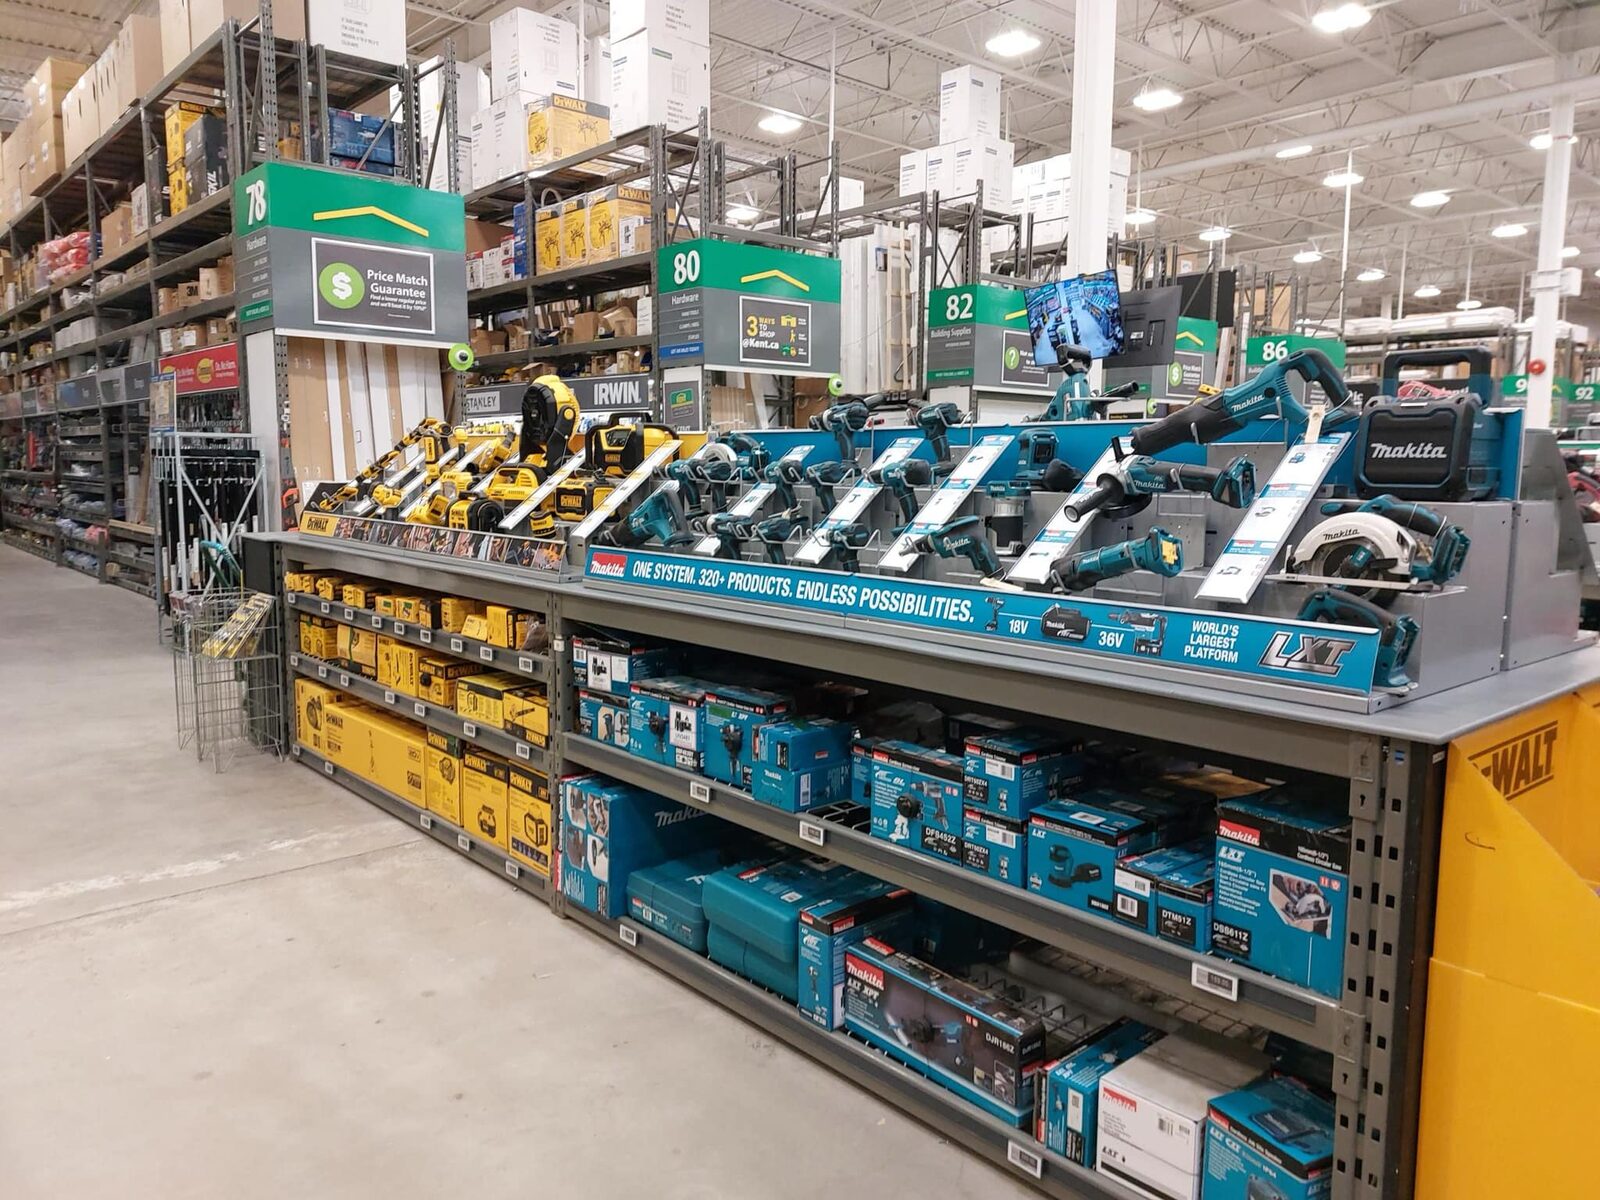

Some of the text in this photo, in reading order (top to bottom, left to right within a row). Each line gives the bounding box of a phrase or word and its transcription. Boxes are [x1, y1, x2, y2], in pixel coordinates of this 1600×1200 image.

[246, 179, 267, 226] 78
[673, 250, 700, 285] 80
[367, 269, 428, 287] Price Match
[186, 285, 198, 297] 3M
[370, 282, 426, 299] Guarantee
[671, 292, 699, 305] Hardware
[946, 293, 973, 320] 82
[746, 315, 775, 337] 3 WAYS
[930, 327, 971, 339] Building Supplies
[742, 338, 779, 349] @Kent.ca
[1262, 340, 1288, 361] 86
[594, 380, 640, 405] IRWIN
[1515, 378, 1527, 393] 9
[1575, 387, 1595, 400] 92
[632, 560, 974, 623] ONE SYSTEM. 320+ PRODUCTS. ENDLESS POSSIBILITIES.
[1008, 619, 1029, 634] 18V
[1192, 620, 1240, 636] WORLD'S
[1098, 631, 1124, 648] 36V
[1190, 633, 1237, 649] LARGEST
[1184, 645, 1239, 663] PLATFORM
[1258, 630, 1356, 678] LXT
[1474, 727, 1558, 797] WALT
[1297, 852, 1315, 863] Cordless
[1315, 856, 1332, 868] Circular
[862, 985, 880, 1000] XPT
[1102, 1145, 1119, 1158] LXT
